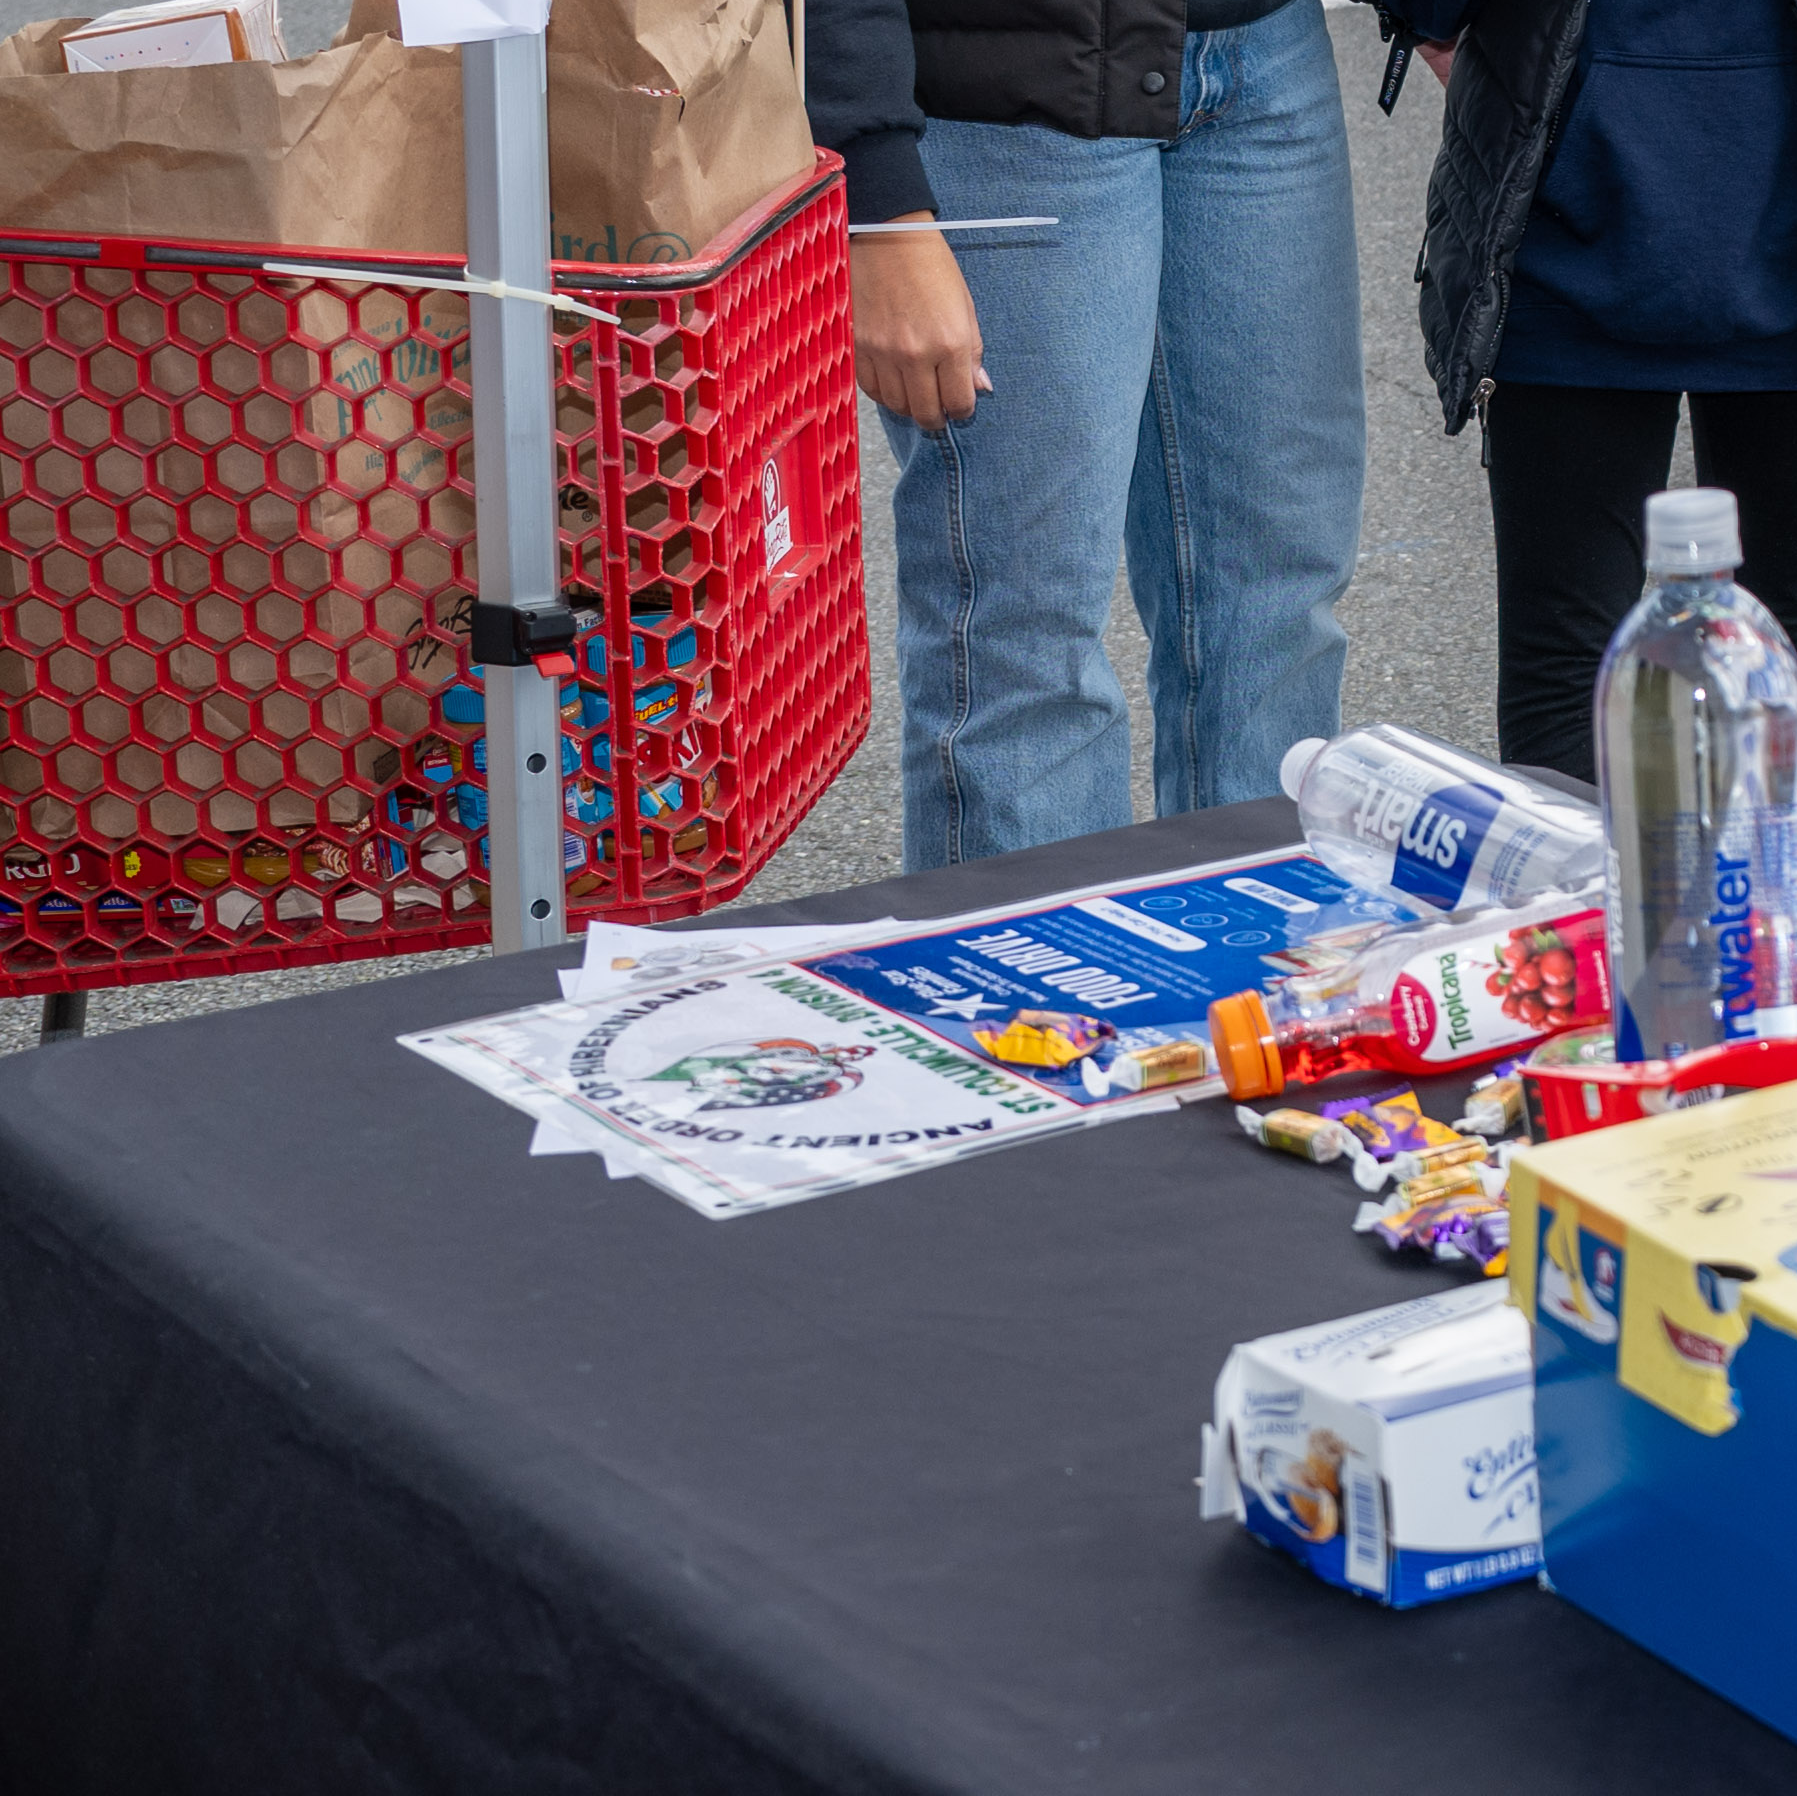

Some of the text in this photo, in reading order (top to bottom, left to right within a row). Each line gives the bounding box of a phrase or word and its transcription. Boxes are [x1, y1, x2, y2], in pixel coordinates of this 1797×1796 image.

[1353, 777, 1468, 870] smart
[956, 925, 1083, 976] DRIVE
[762, 969, 879, 1024] DIVISION
[1058, 966, 1159, 1011] FOOD
[1399, 984, 1421, 1047] Cranberry
[1439, 952, 1475, 1050] Tropicana
[571, 979, 728, 1075] HIBERNIANS
[862, 1022, 1033, 1097] COLUMCILLE
[603, 1102, 746, 1143] ORDER
[997, 1090, 1058, 1114] ST.
[752, 1115, 996, 1151] ANCIENT
